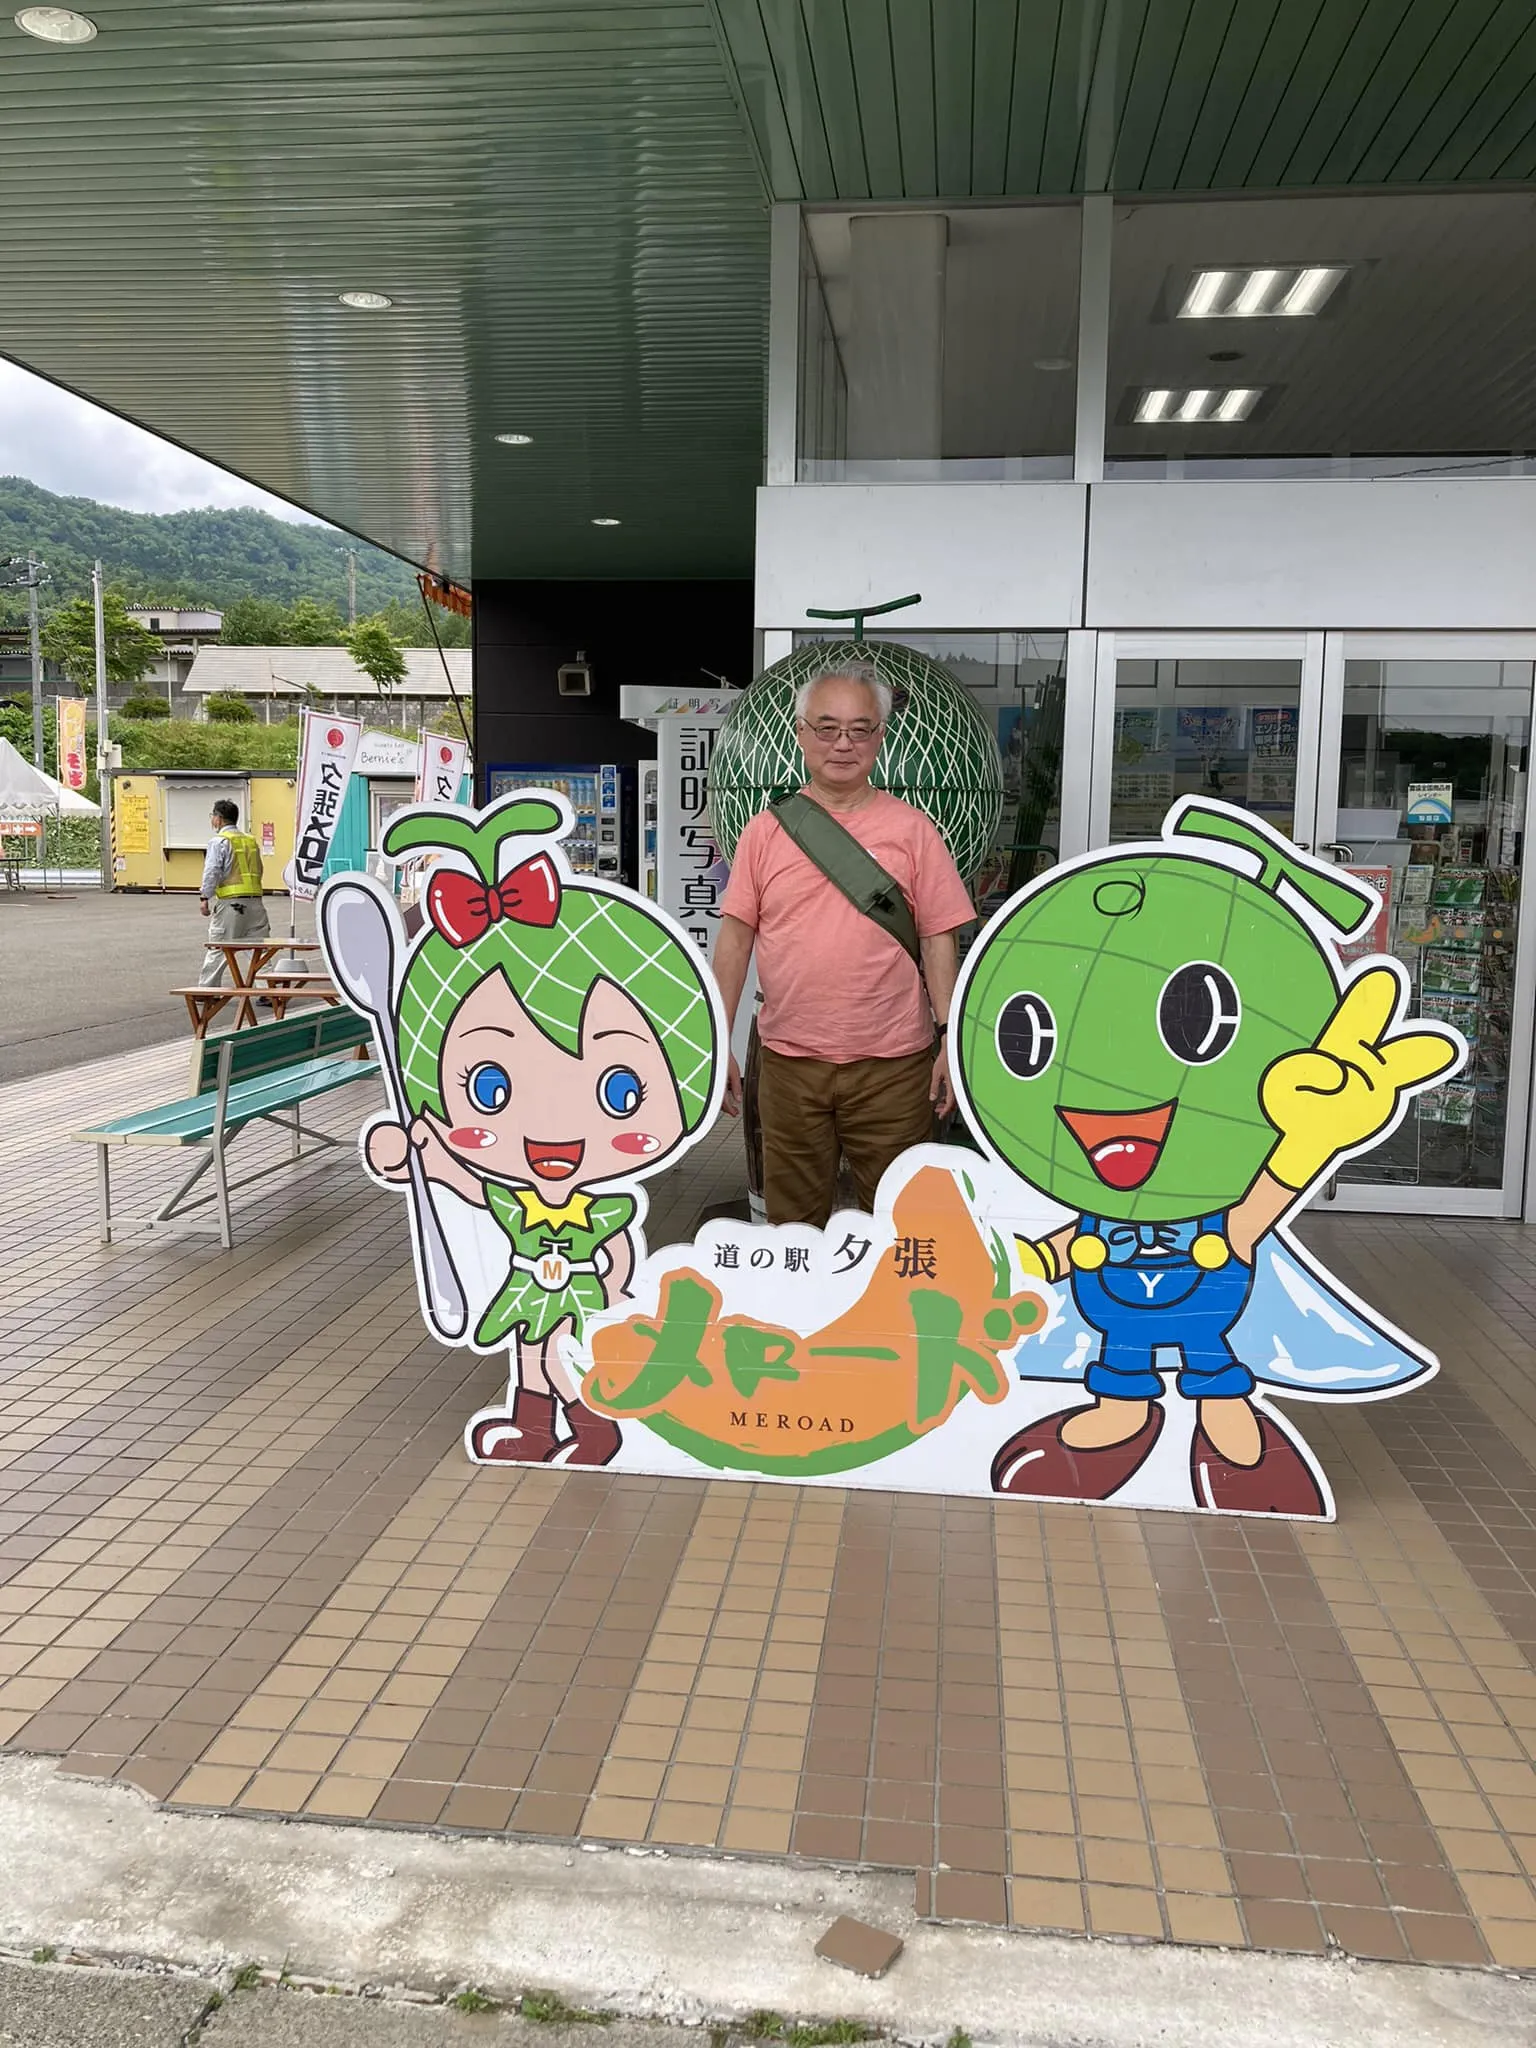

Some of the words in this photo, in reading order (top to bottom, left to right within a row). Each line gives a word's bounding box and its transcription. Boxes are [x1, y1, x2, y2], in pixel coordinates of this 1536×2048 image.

[361, 751, 405, 764] Bernie's
[679, 728, 720, 918] 証明写真
[714, 1243, 811, 1274] 道の駅
[832, 1232, 937, 1280] 夕張
[543, 1260, 562, 1280] M
[1137, 1271, 1165, 1298] Y
[590, 1277, 1040, 1425] メロード
[729, 1411, 856, 1434] MEROAD
